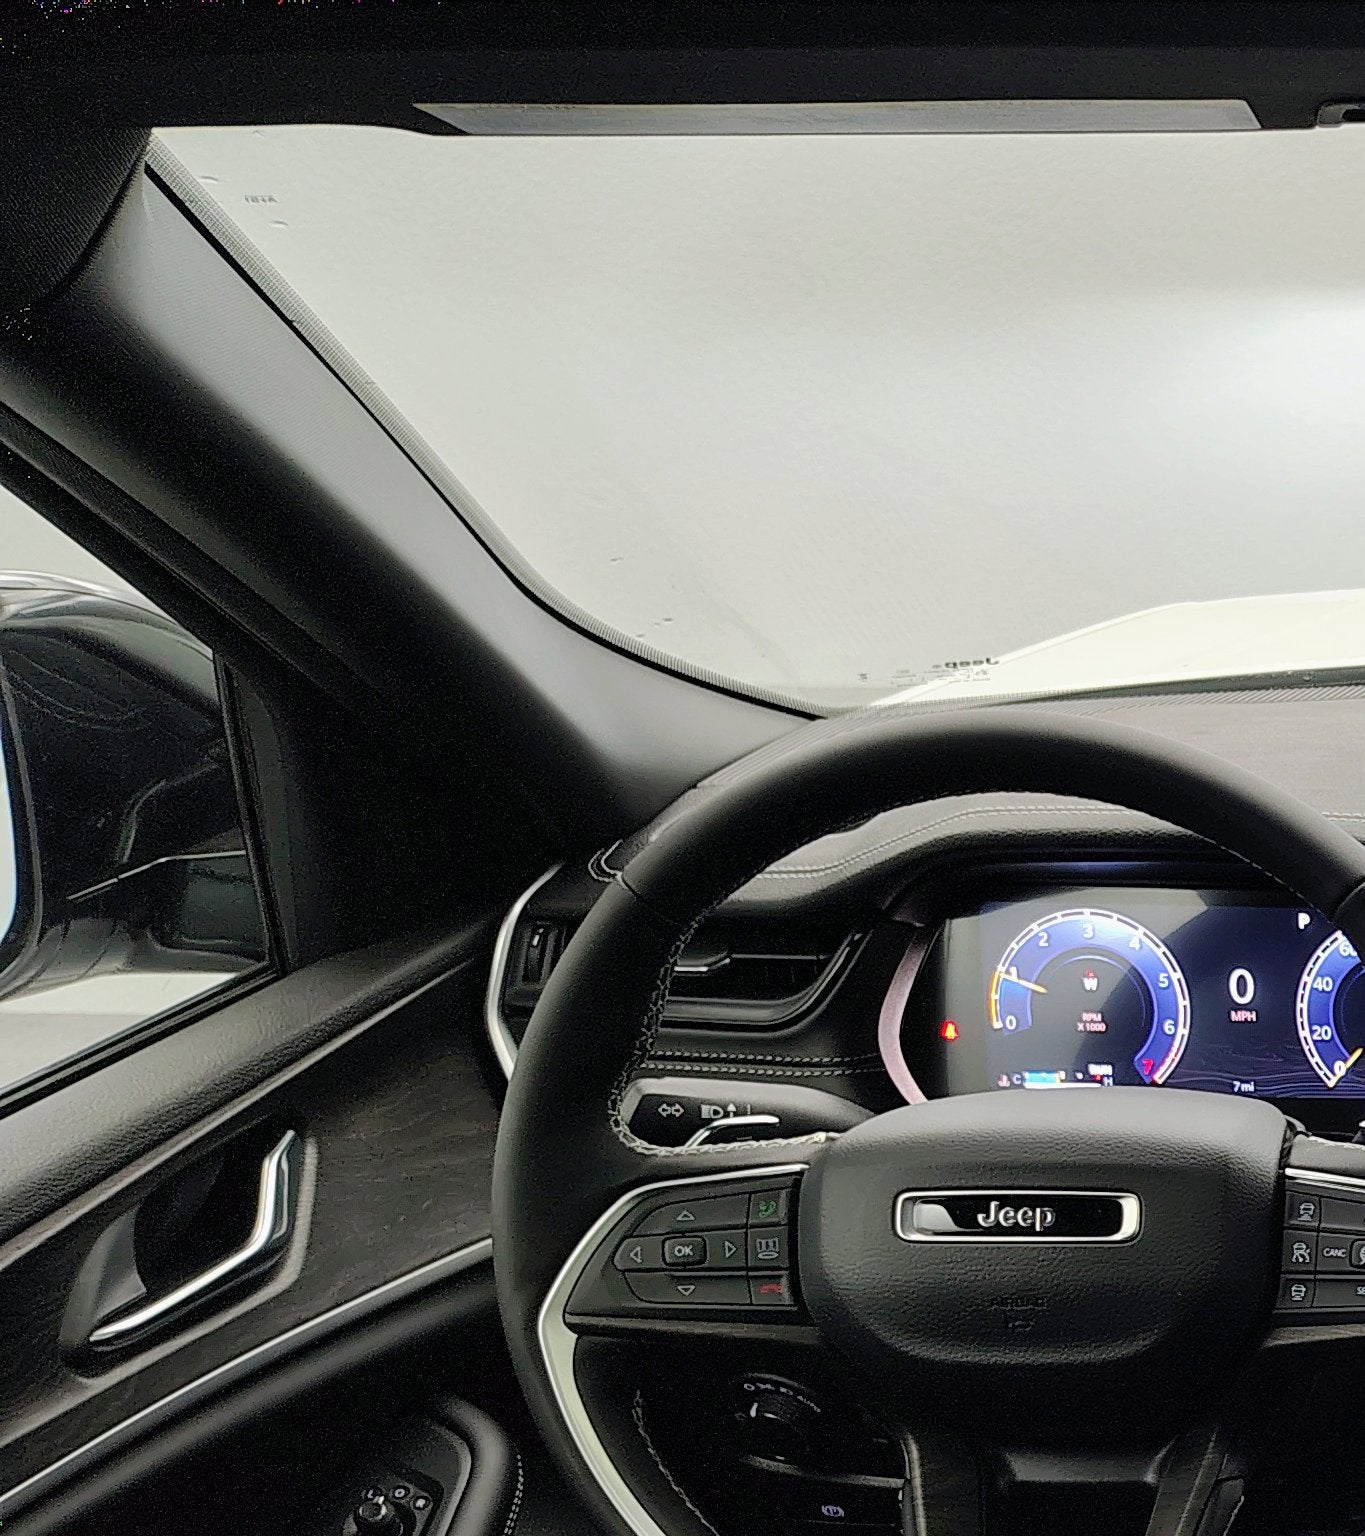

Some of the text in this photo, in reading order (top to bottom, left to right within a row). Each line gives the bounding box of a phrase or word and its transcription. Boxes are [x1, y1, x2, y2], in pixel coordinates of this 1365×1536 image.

[1297, 912, 1311, 930] P
[1083, 924, 1094, 938] 3
[1038, 932, 1049, 947] 2
[1129, 936, 1142, 950] 4
[1082, 977, 1098, 991] W
[1159, 973, 1169, 988] 5
[1228, 968, 1255, 1005] 0
[1312, 977, 1333, 992] 40
[1005, 1015, 1017, 1030] 0
[1082, 1012, 1102, 1022] RPM
[1230, 1010, 1257, 1022] MPH
[1077, 1023, 1107, 1032] X 1000
[1163, 1020, 1176, 1035] 6
[1311, 1025, 1332, 1041] 20
[1142, 1059, 1153, 1074] 7
[1333, 1060, 1347, 1077] 0
[1013, 1074, 1022, 1085] C
[977, 1201, 1056, 1232] Jeep
[674, 1245, 694, 1257] OK
[1323, 1247, 1347, 1258] CANC
